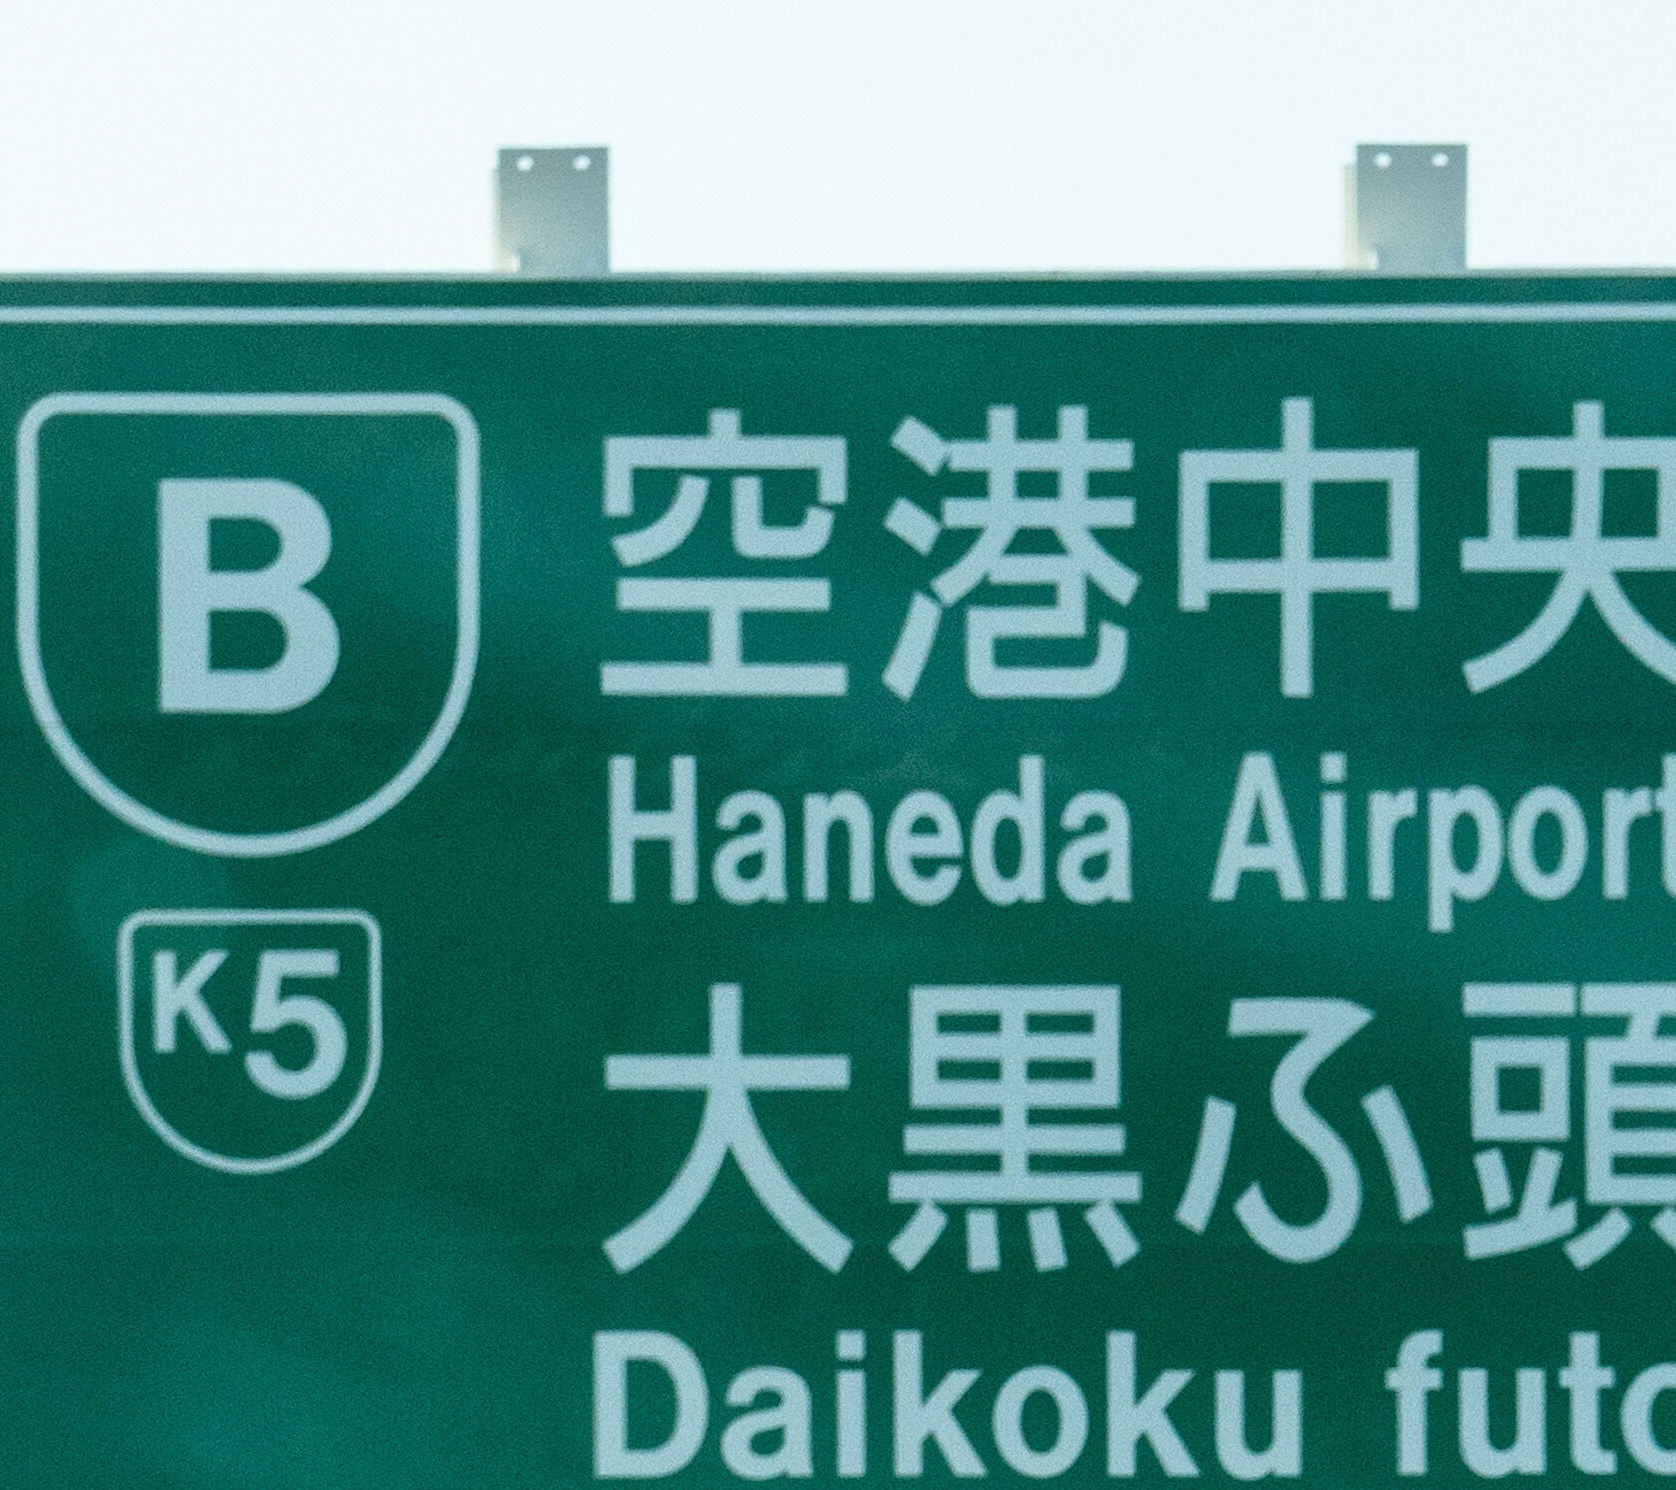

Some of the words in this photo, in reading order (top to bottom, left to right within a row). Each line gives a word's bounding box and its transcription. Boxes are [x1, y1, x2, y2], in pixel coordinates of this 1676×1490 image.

[158, 478, 339, 713] B
[609, 755, 1131, 905] Haneda
[151, 948, 350, 1100] K5
[594, 1331, 1301, 1480] Daikoku
